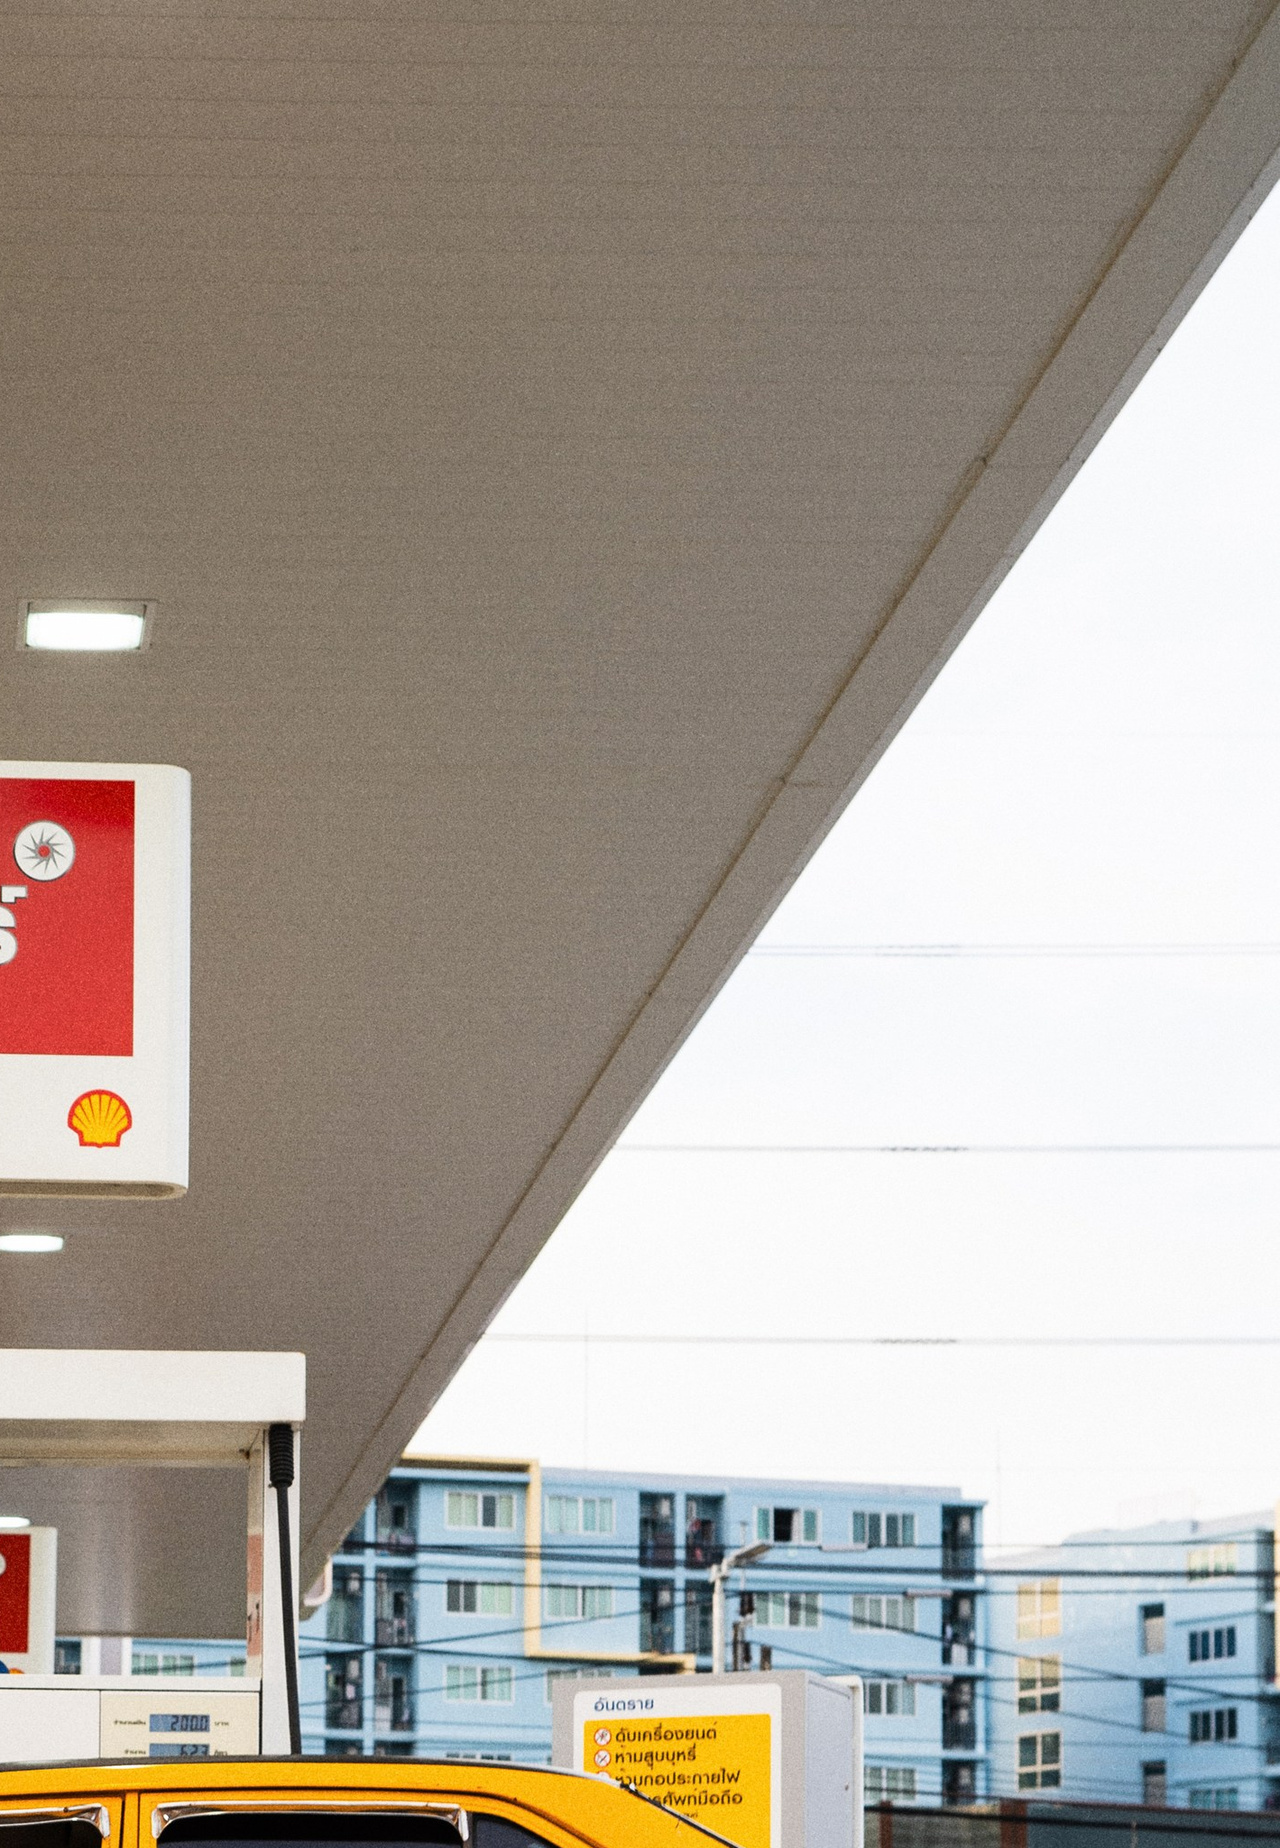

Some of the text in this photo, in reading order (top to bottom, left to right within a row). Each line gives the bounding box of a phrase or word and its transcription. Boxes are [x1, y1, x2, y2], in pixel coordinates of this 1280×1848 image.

[594, 1697, 654, 1712] อันตราย
[615, 1721, 717, 1742] ดับเครื่องยนต์
[615, 1743, 696, 1767] ห้ามสูบบุหรี่
